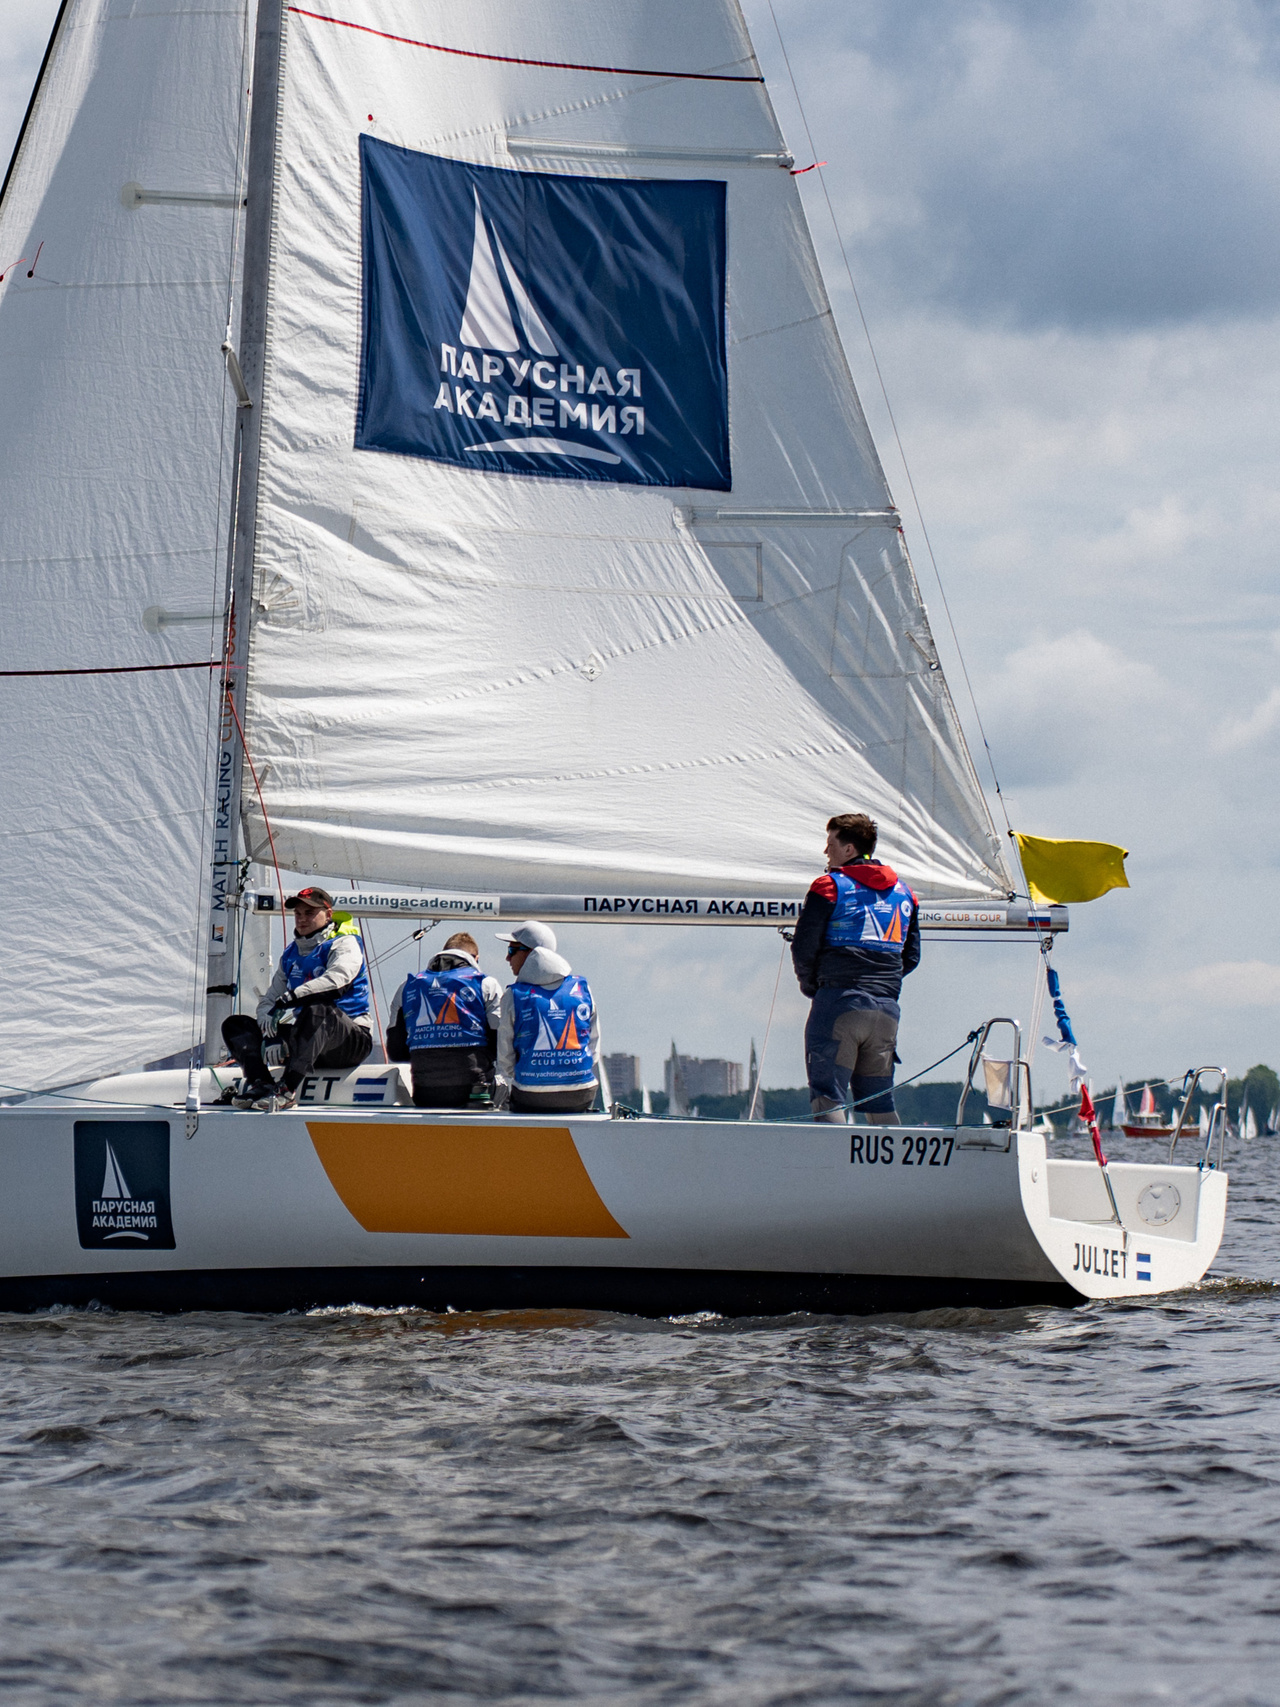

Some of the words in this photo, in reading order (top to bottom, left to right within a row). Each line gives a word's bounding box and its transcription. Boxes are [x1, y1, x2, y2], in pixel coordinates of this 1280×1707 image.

[440, 342, 642, 398] ПАРУСНАЯ
[433, 382, 645, 436] АКАДЕМИЯ
[215, 751, 232, 828] RACING
[211, 838, 228, 911] MATCH
[583, 897, 699, 914] ПАРУСНАЯ
[706, 899, 802, 918] АКАДЕМ
[918, 912, 942, 921] CING
[944, 912, 970, 922] CLUB
[974, 913, 1002, 922] TOUR
[414, 1025, 436, 1033] MATCH
[531, 1050, 556, 1058] MATCH
[559, 1057, 583, 1065] TOUR
[850, 1134, 894, 1165] RUS
[901, 1136, 955, 1166] 2927
[92, 1200, 155, 1213] ПАРУСНАЯ
[92, 1215, 158, 1229] АКАДЕМИЯ
[1072, 1242, 1127, 1279] JULIET
